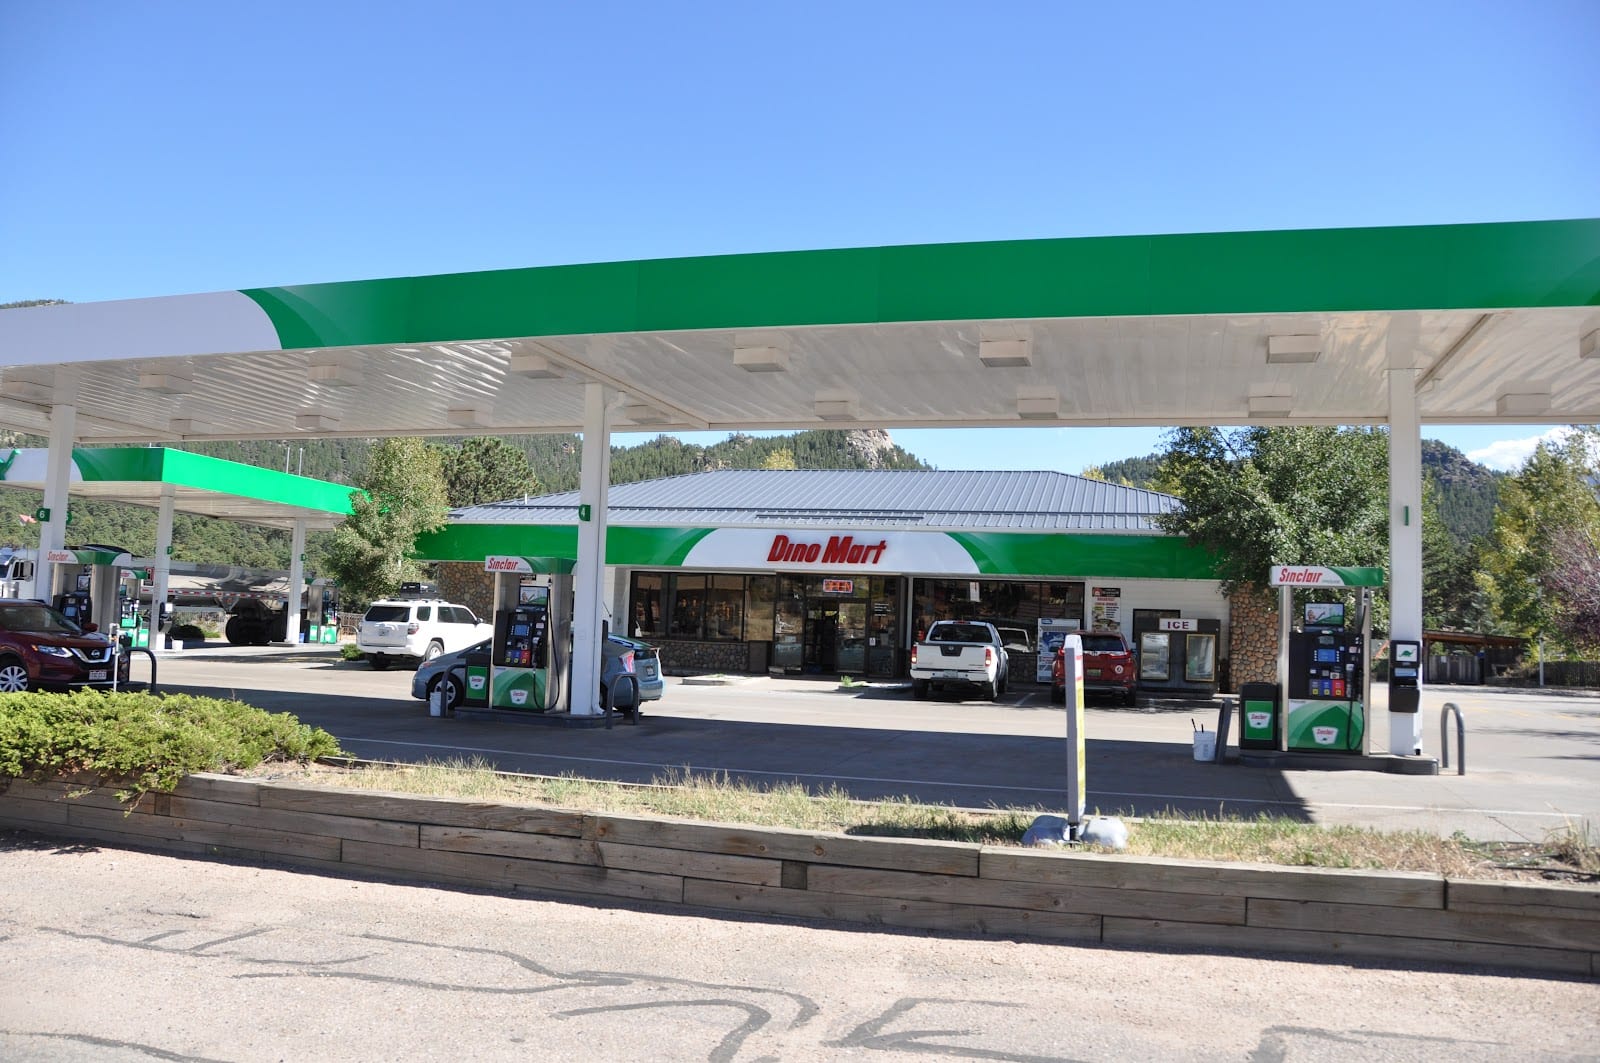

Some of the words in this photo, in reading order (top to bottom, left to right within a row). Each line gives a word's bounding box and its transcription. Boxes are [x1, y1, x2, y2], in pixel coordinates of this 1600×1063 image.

[39, 510, 46, 519] 6
[767, 535, 822, 563] Dino
[821, 536, 887, 565] Mart
[488, 557, 519, 570] Sinclair
[1279, 568, 1323, 583] Sinclair
[825, 581, 852, 592] OPEN
[1167, 621, 1190, 630] ICE
